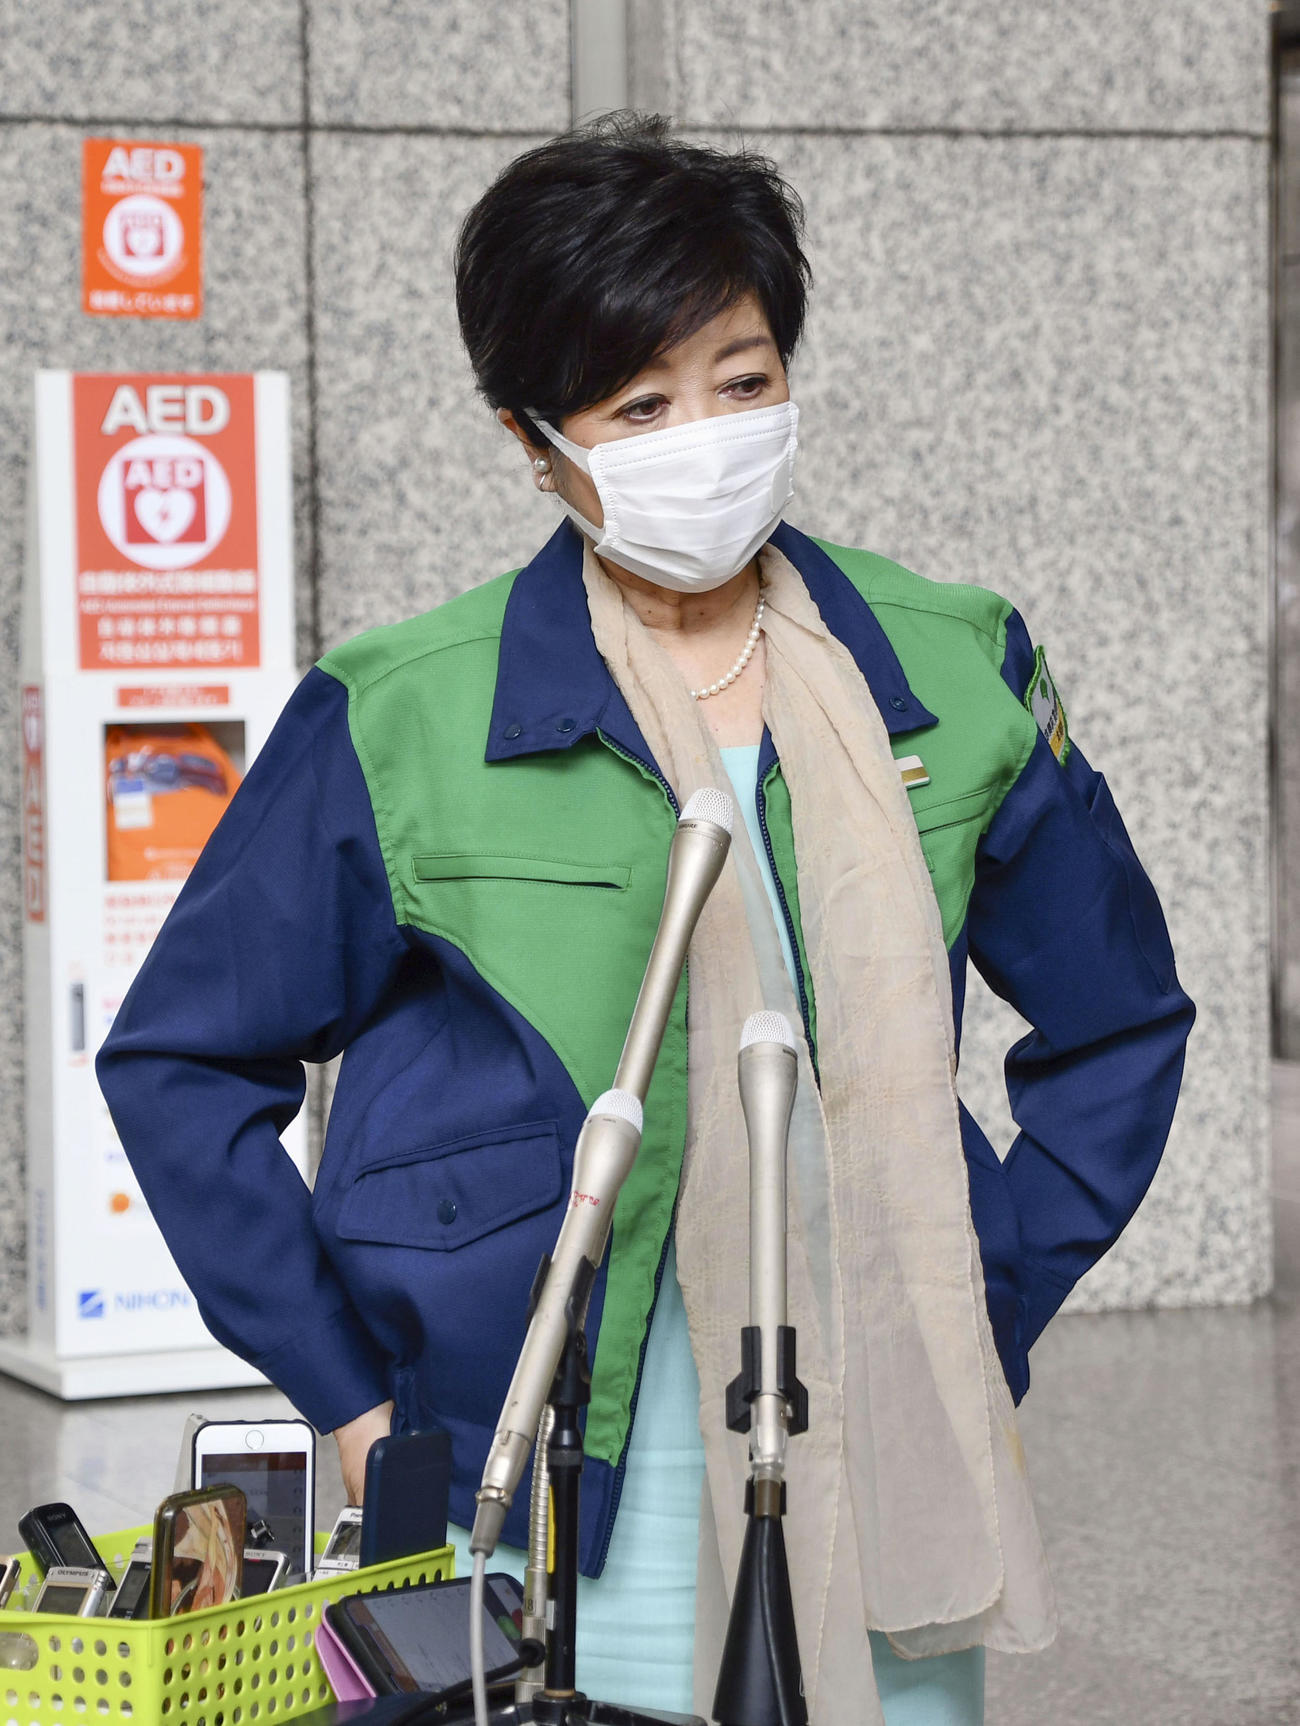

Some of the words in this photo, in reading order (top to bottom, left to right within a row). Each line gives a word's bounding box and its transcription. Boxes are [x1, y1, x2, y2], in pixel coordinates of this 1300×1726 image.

[102, 147, 186, 182] AED
[101, 385, 230, 435] AED
[124, 461, 204, 489] AED
[57, 1569, 89, 1577] OLYMPUS
